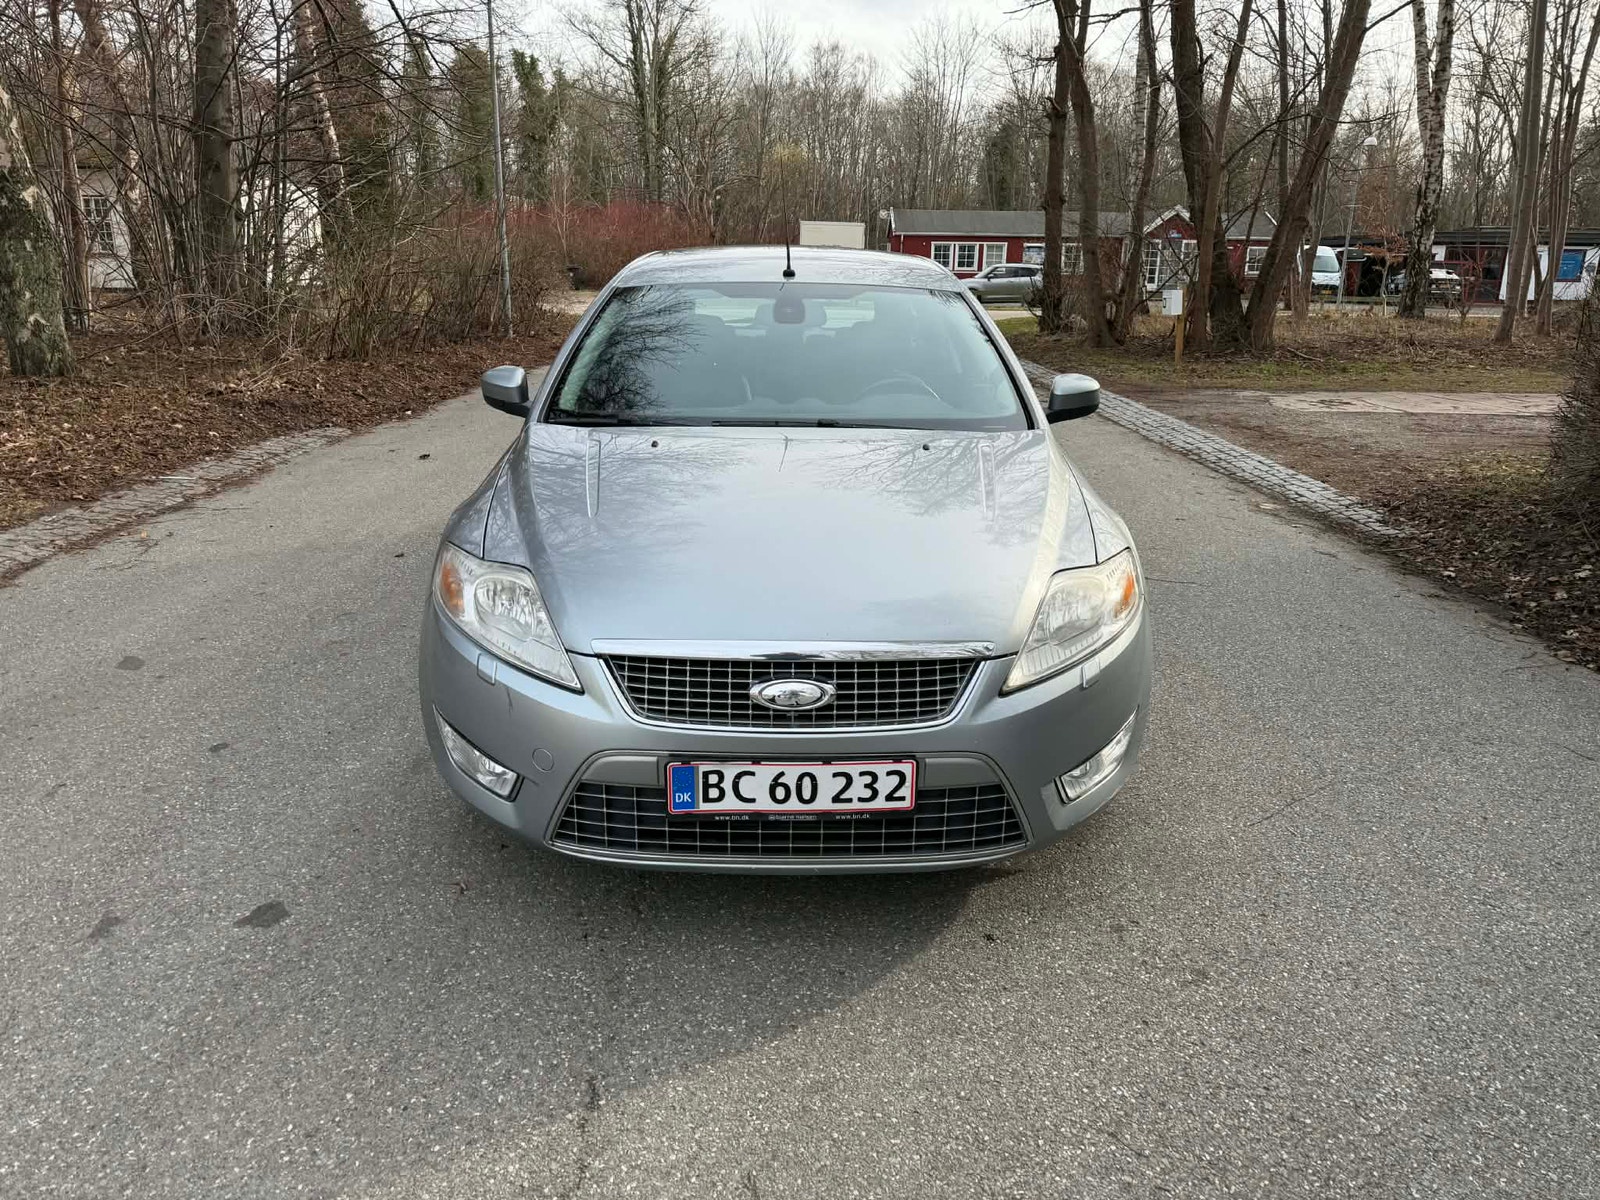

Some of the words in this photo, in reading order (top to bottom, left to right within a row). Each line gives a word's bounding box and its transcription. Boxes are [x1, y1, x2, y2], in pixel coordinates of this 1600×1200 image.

[675, 792, 692, 803] DK
[702, 769, 757, 804] BC
[768, 770, 819, 805] 60
[831, 769, 907, 804] 232
